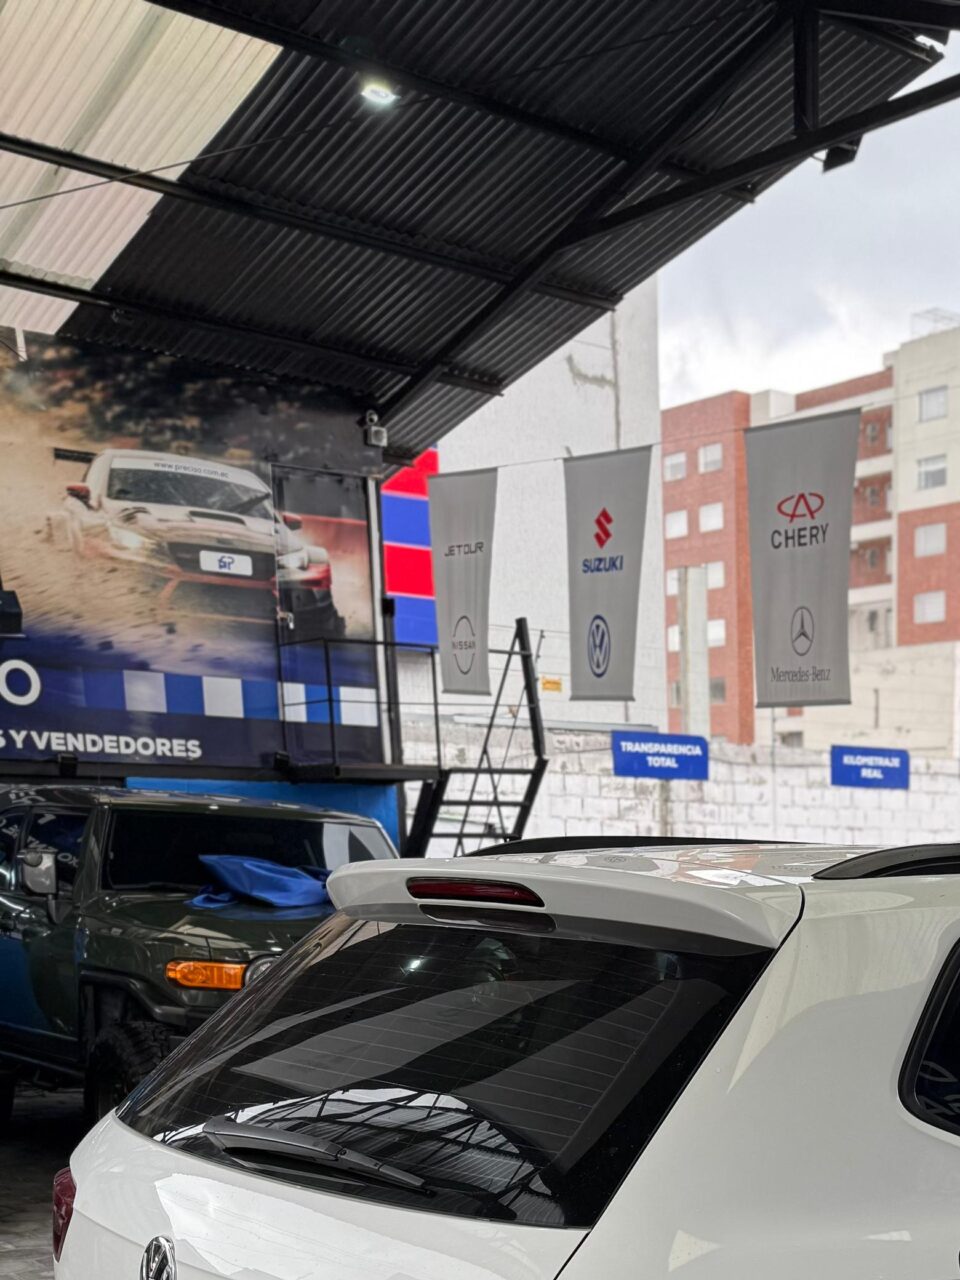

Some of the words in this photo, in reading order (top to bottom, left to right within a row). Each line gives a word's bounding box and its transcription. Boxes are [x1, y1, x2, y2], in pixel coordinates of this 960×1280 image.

[770, 523, 829, 550] CHERY
[444, 541, 485, 557] JETOUR
[582, 555, 624, 574] SUZUKI
[452, 640, 476, 651] NISSAN
[770, 665, 831, 682] Mercedes-Benz
[8, 729, 28, 749] Y
[30, 731, 202, 759] VENDEDORES
[620, 741, 702, 756] TRANSPARENCIA
[646, 755, 679, 768] TOTAL
